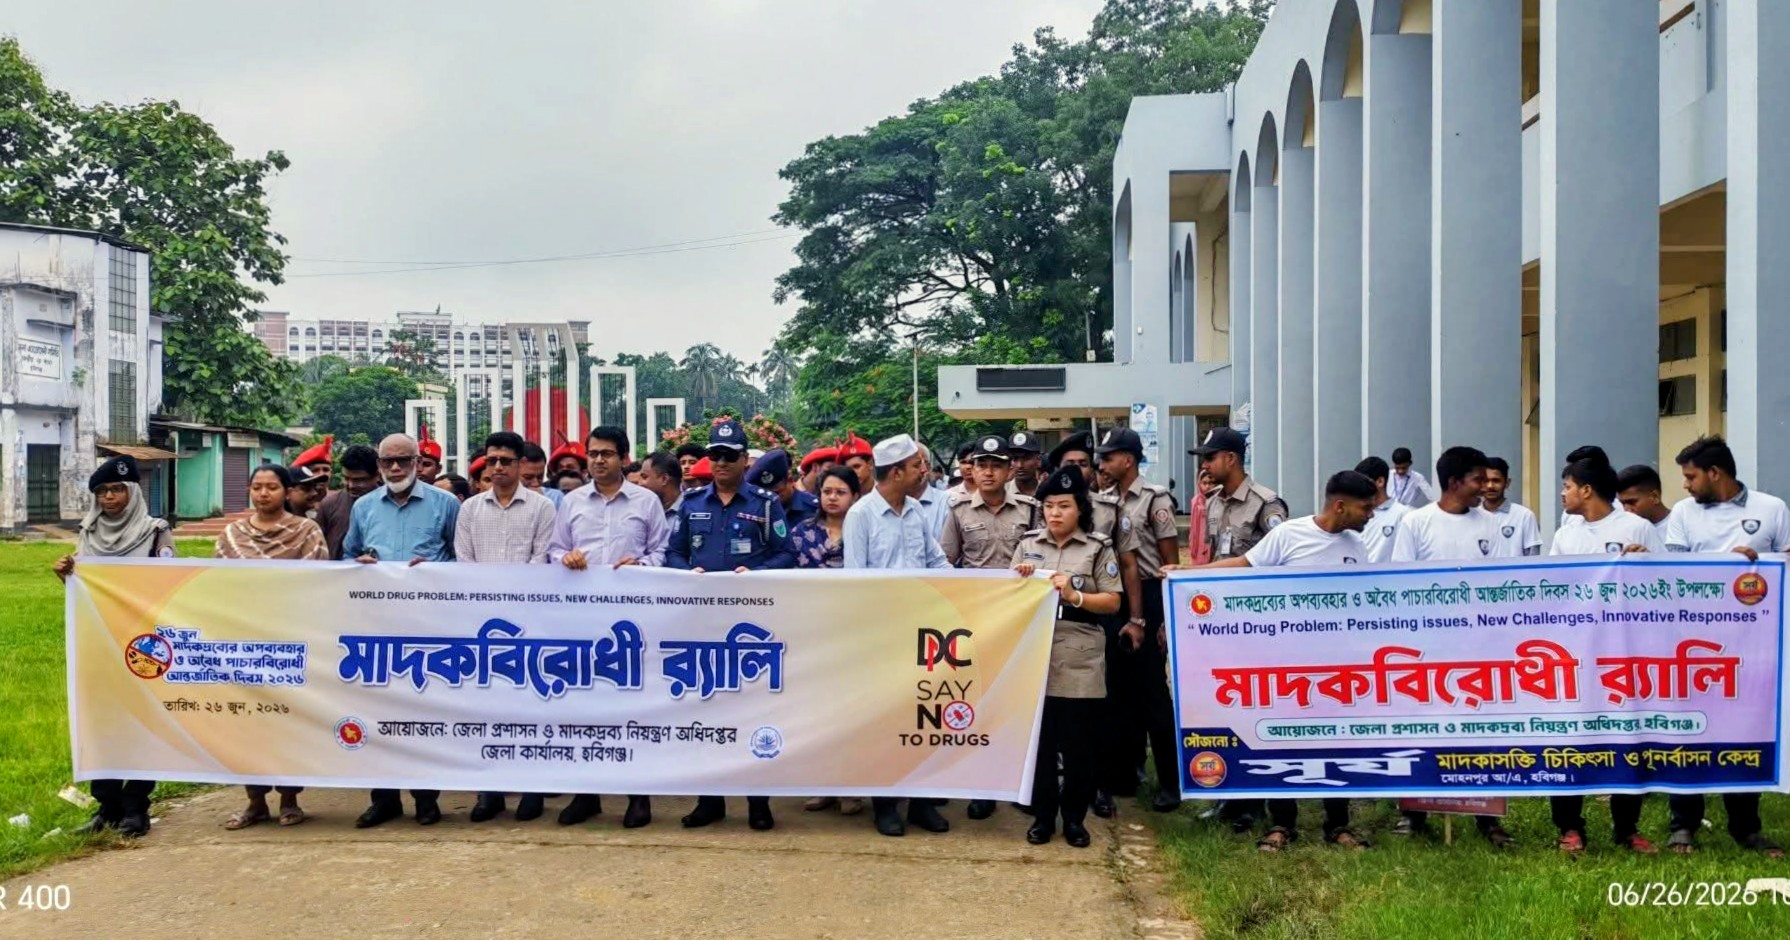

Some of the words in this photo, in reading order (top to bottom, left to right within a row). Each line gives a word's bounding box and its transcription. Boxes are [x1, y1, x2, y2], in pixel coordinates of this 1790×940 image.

[349, 591, 385, 600] WORLD
[387, 592, 415, 600] DRUG
[418, 592, 467, 601] PROBLEM:
[470, 592, 525, 602] PERSISTING
[528, 594, 563, 603] ISSUES,
[566, 595, 587, 604] NEW
[589, 595, 654, 605] CHALLENGES,
[657, 596, 715, 606] INNOVATIVE
[717, 598, 774, 606] RESPONSES
[1223, 595, 1286, 613] মাদকদ্রব্যের
[1290, 592, 1347, 613] অপব্যবহার
[1352, 593, 1361, 607] ও
[1365, 586, 1396, 607] অবৈধ
[1401, 581, 1471, 606] পাচারবিরোধী
[1475, 580, 1536, 603] আন্তর্জাতিক
[1540, 579, 1570, 600] দিবস
[1574, 583, 1594, 602] ২৬
[1198, 623, 1238, 636] World
[1243, 622, 1276, 636] Drug
[1281, 620, 1342, 633] Problem:
[1348, 616, 1418, 632] Persisting
[1423, 616, 1473, 628] issues,
[1478, 614, 1508, 626] New
[1512, 612, 1598, 626] Challenges,
[1602, 610, 1675, 622] Innovative
[1679, 610, 1757, 624] Responses
[156, 627, 176, 638] ২৬
[173, 642, 238, 654] মাদকদ্রব্যের
[242, 643, 305, 655] অপব্যবহার
[175, 656, 184, 665] ও
[187, 654, 221, 667] অবৈধ
[225, 654, 304, 670] পাচারবিরোধী
[338, 618, 644, 698] মাদকবিরোধী
[167, 668, 230, 681] আন্তর্জাতিক
[234, 670, 263, 683] দিবস
[268, 674, 304, 684] ২০২৬
[1212, 639, 1580, 708] মাদকবিরোধী
[917, 680, 973, 700] SAY
[205, 702, 222, 713] ২৬
[256, 702, 290, 714] ২০২৬
[452, 722, 488, 738] জেলা
[491, 722, 537, 739] প্রশাসন
[542, 724, 554, 739] ও
[559, 724, 622, 740] মাদকদ্রব্য
[626, 720, 671, 743] নিয়ন্ত্রণ
[676, 721, 737, 744] অধিদপ্তর
[1350, 724, 1386, 735] জেলা
[1392, 723, 1439, 735] প্রশাসন
[1444, 723, 1456, 734] ও
[1461, 721, 1525, 734] মাদকদ্রব্য
[1530, 717, 1578, 734] নিয়ন্ত্রণ
[899, 734, 923, 746] TO
[930, 734, 990, 746] DRUGS
[481, 744, 515, 760] জেলা
[1436, 748, 1537, 770] মাদকাসক্তি
[1541, 747, 1616, 768] চিকিৎসা
[1623, 752, 1639, 766] ও
[1718, 750, 1762, 768] কেন্দ্র
